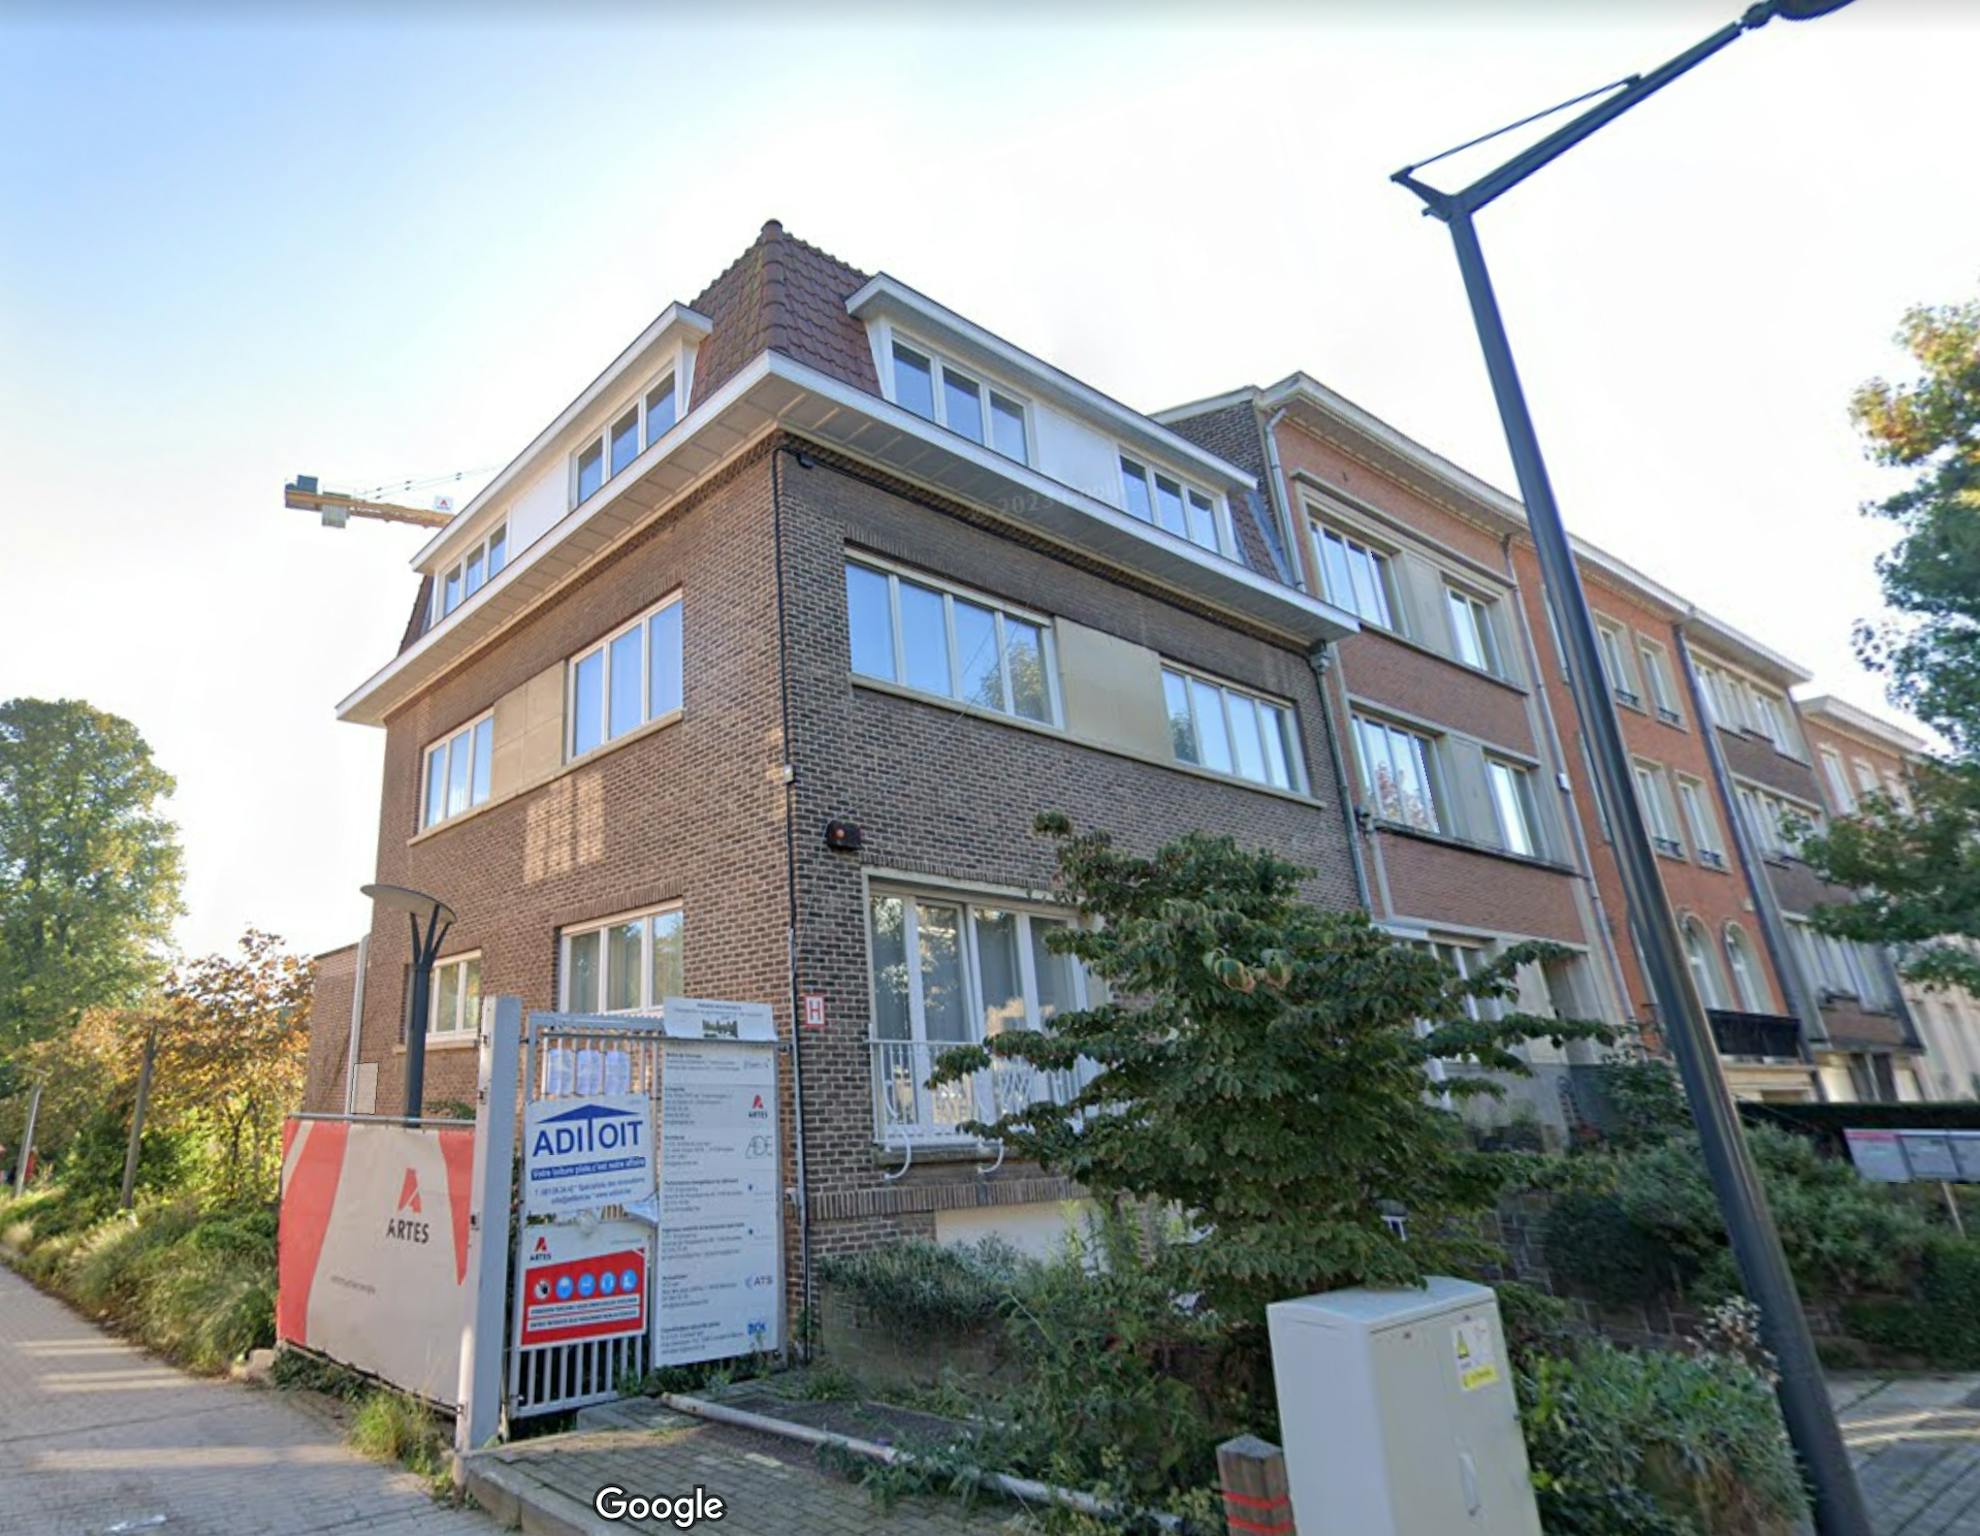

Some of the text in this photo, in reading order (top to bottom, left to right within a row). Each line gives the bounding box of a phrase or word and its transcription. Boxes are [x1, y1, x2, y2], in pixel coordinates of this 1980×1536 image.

[809, 999, 821, 1021] H
[532, 1104, 644, 1158] ADITOIT
[386, 1218, 429, 1244] ARTES
